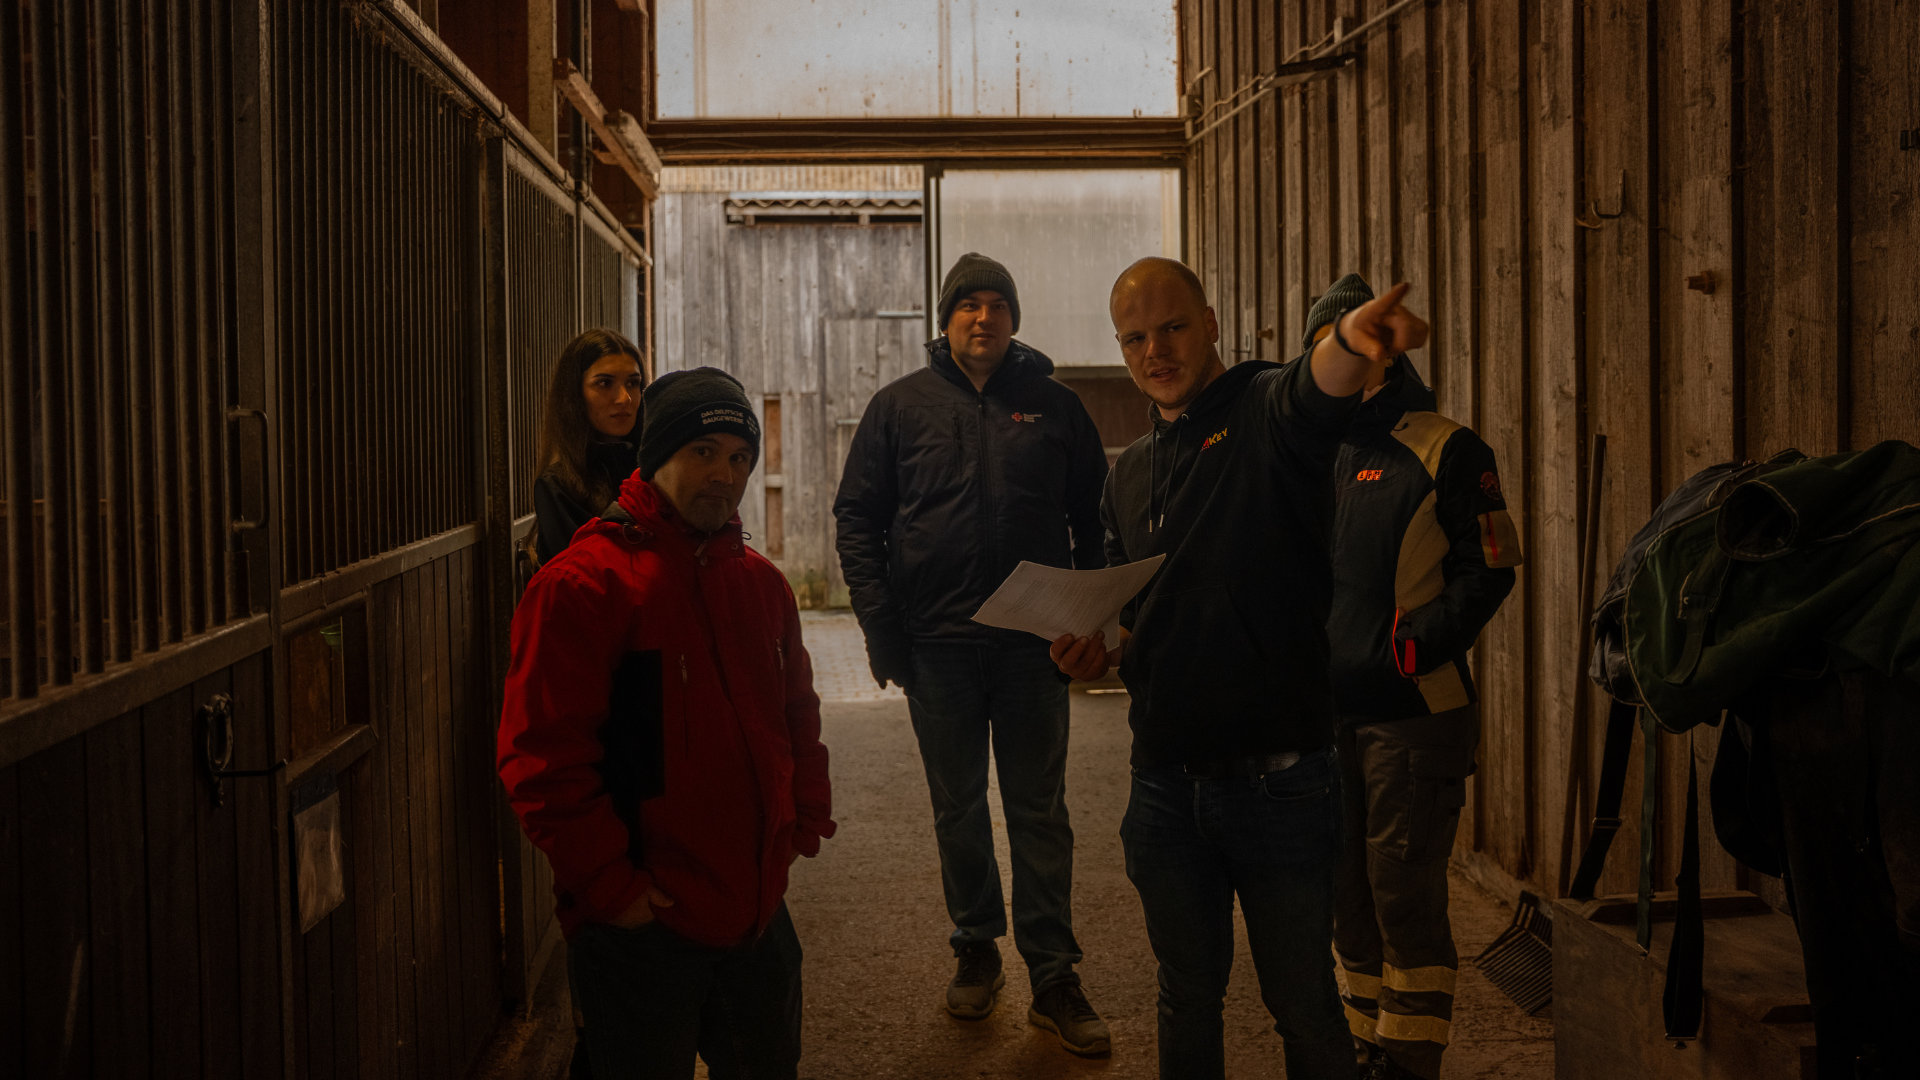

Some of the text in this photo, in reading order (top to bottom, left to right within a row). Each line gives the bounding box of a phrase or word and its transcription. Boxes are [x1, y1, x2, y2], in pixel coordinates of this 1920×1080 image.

[701, 409, 744, 418] DAS DEUTSCHE
[702, 415, 744, 424] BAUGEWERBE
